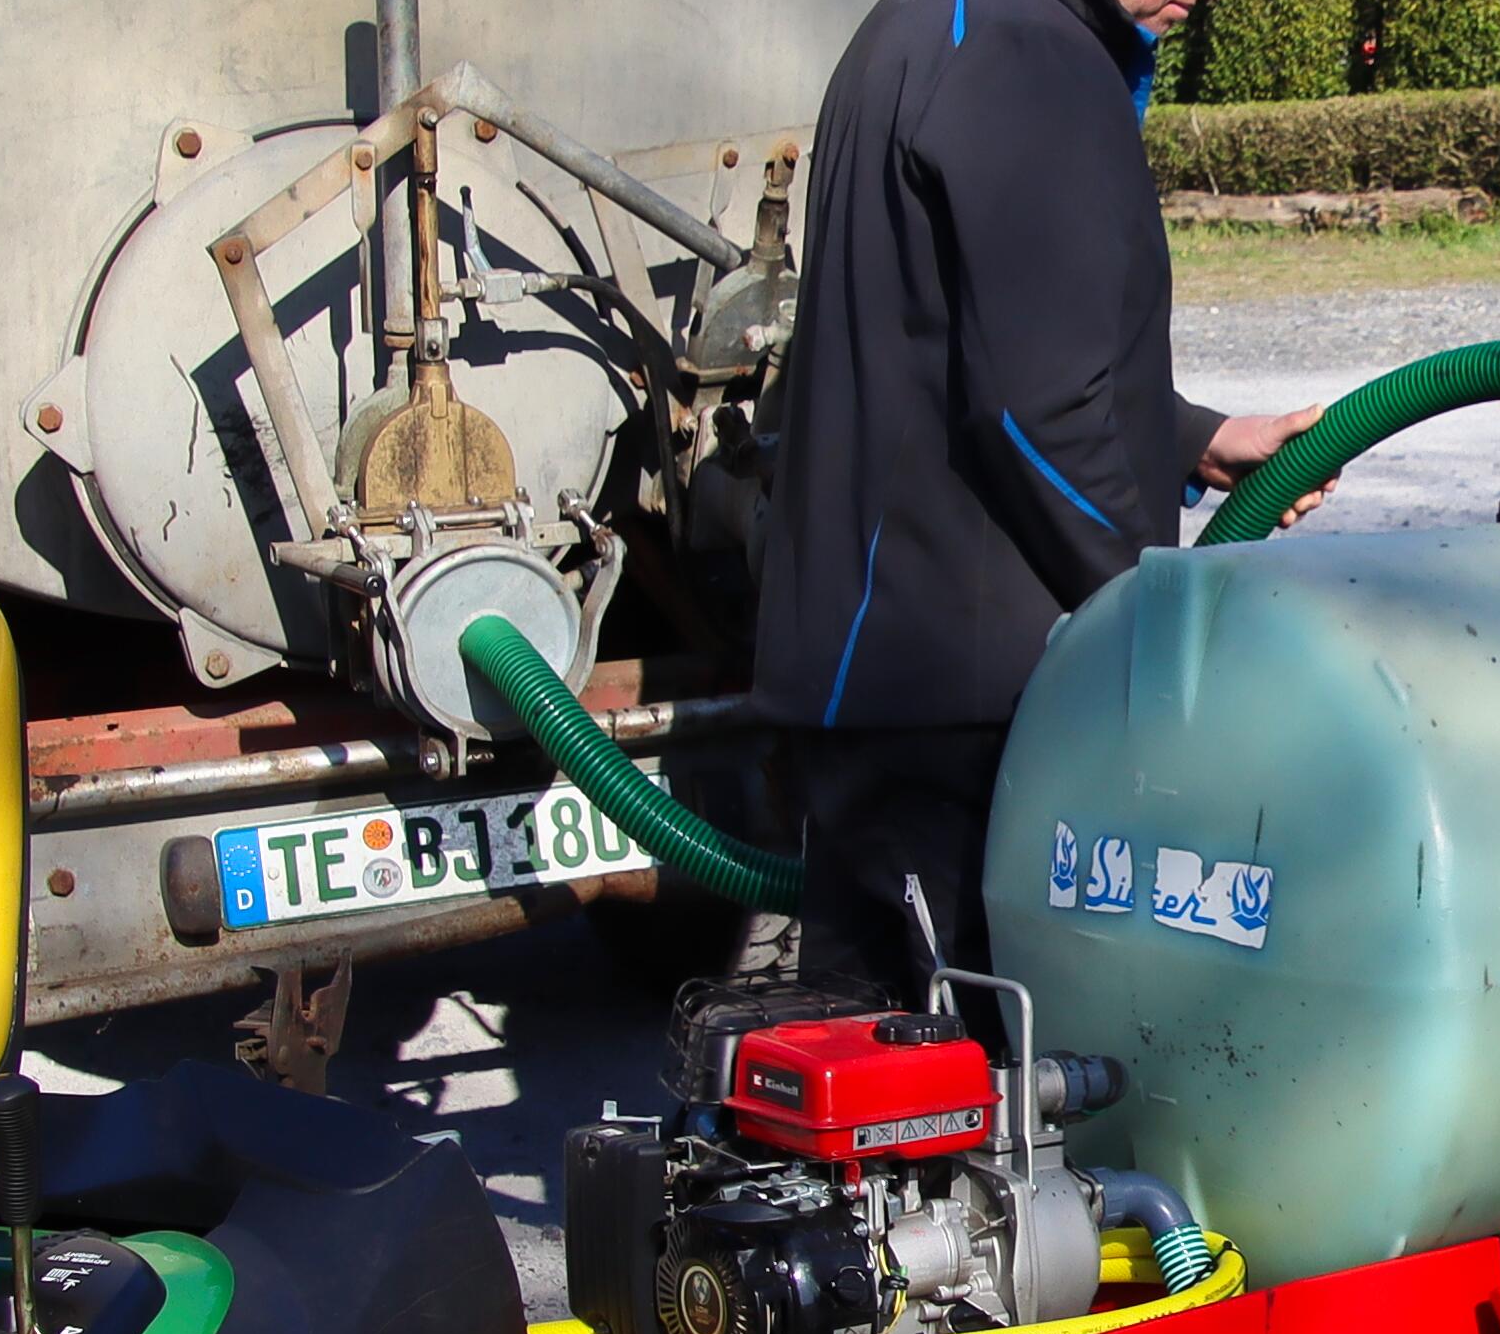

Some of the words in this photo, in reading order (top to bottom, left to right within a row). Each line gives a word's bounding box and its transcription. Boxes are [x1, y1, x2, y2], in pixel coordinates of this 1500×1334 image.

[268, 828, 357, 906] TE
[404, 809, 493, 889] BJ
[506, 797, 651, 876] 180
[237, 889, 254, 911] D
[765, 1077, 799, 1097] Einhell
